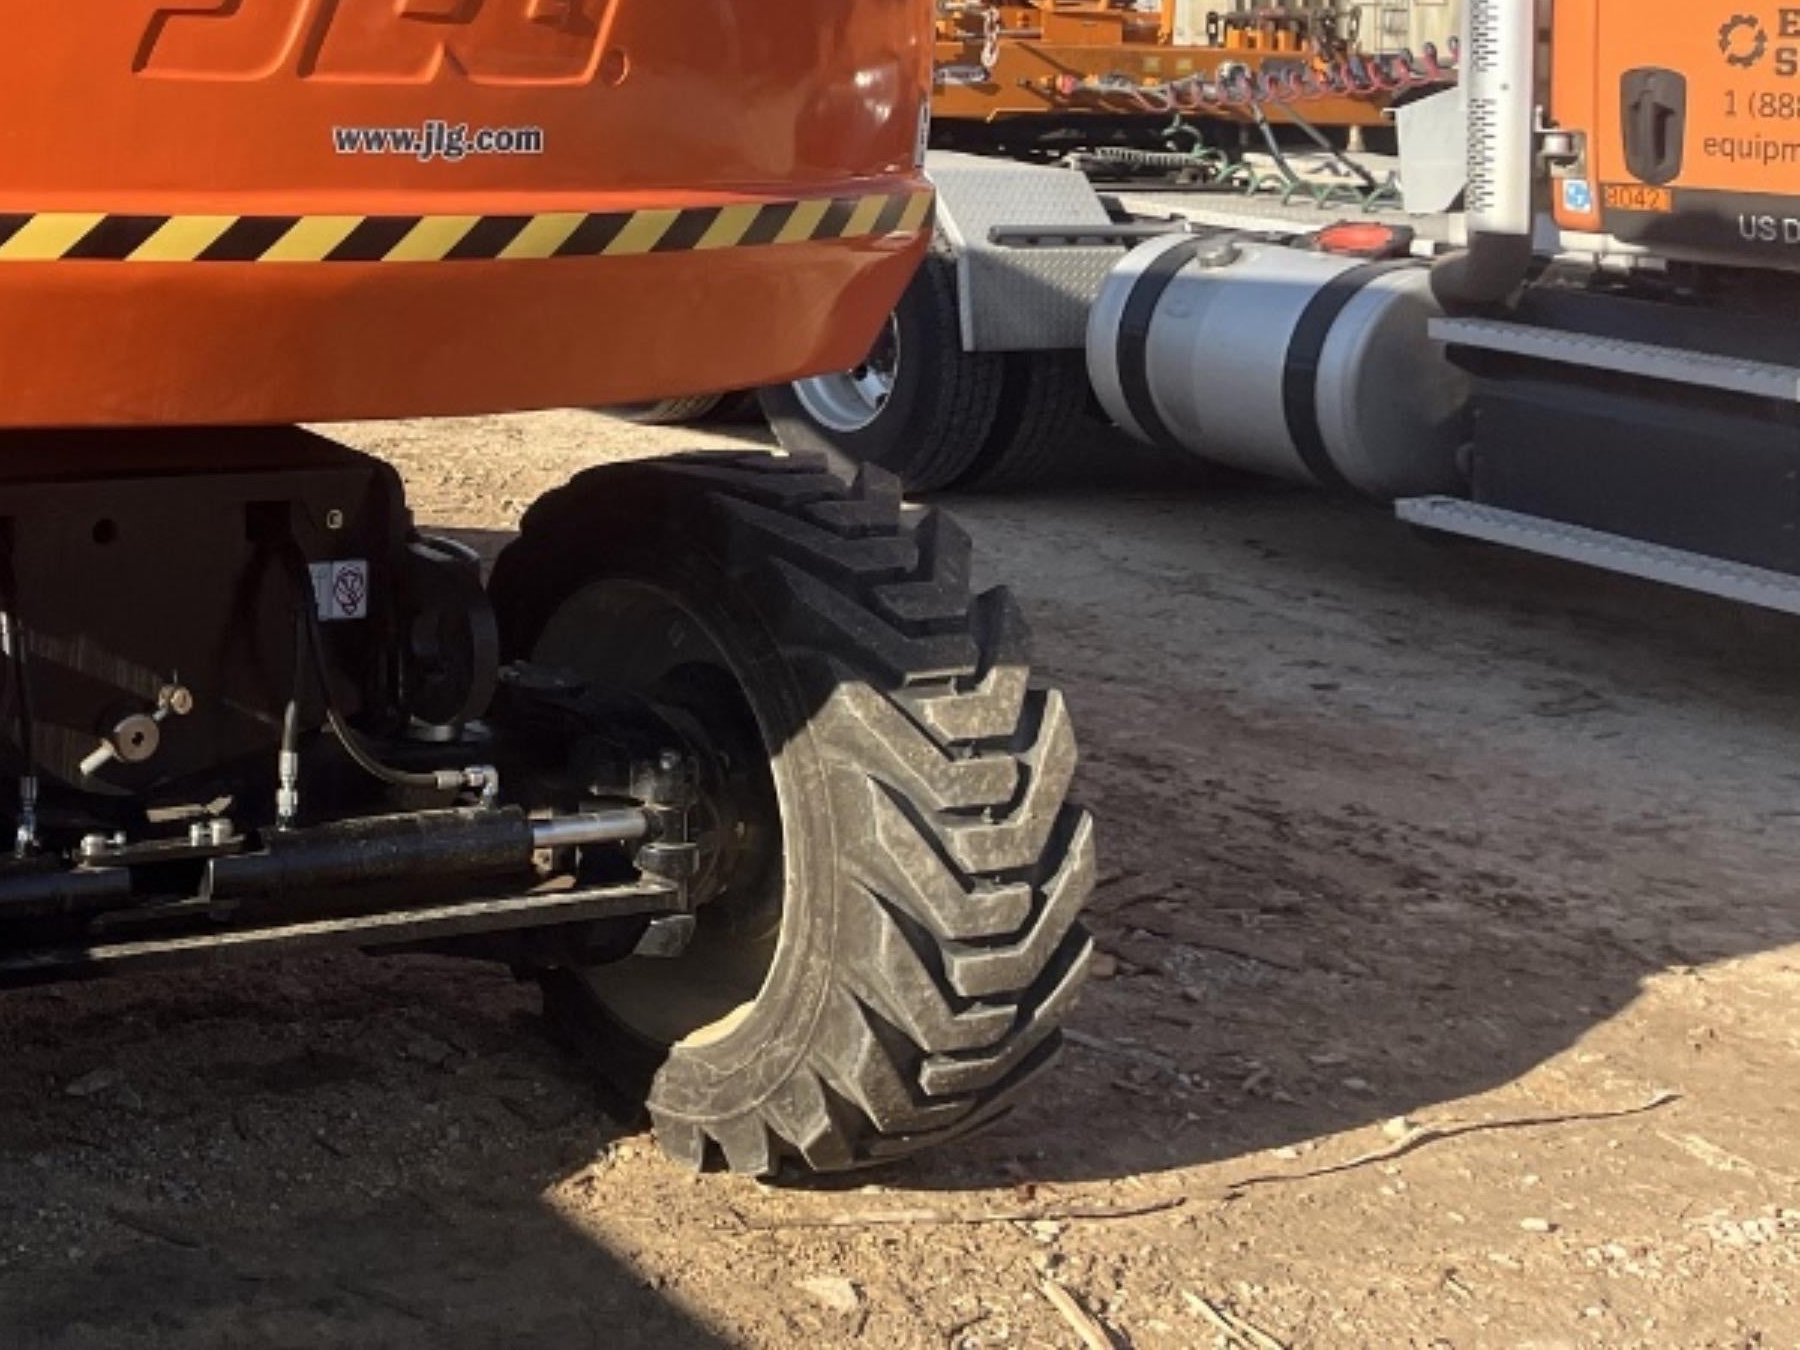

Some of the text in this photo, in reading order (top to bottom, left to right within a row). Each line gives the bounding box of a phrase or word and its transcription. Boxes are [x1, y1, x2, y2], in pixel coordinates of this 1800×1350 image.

[1724, 90, 1800, 119] 1 (88
[333, 121, 543, 161] www.jlg.com
[1739, 214, 1777, 241] US
